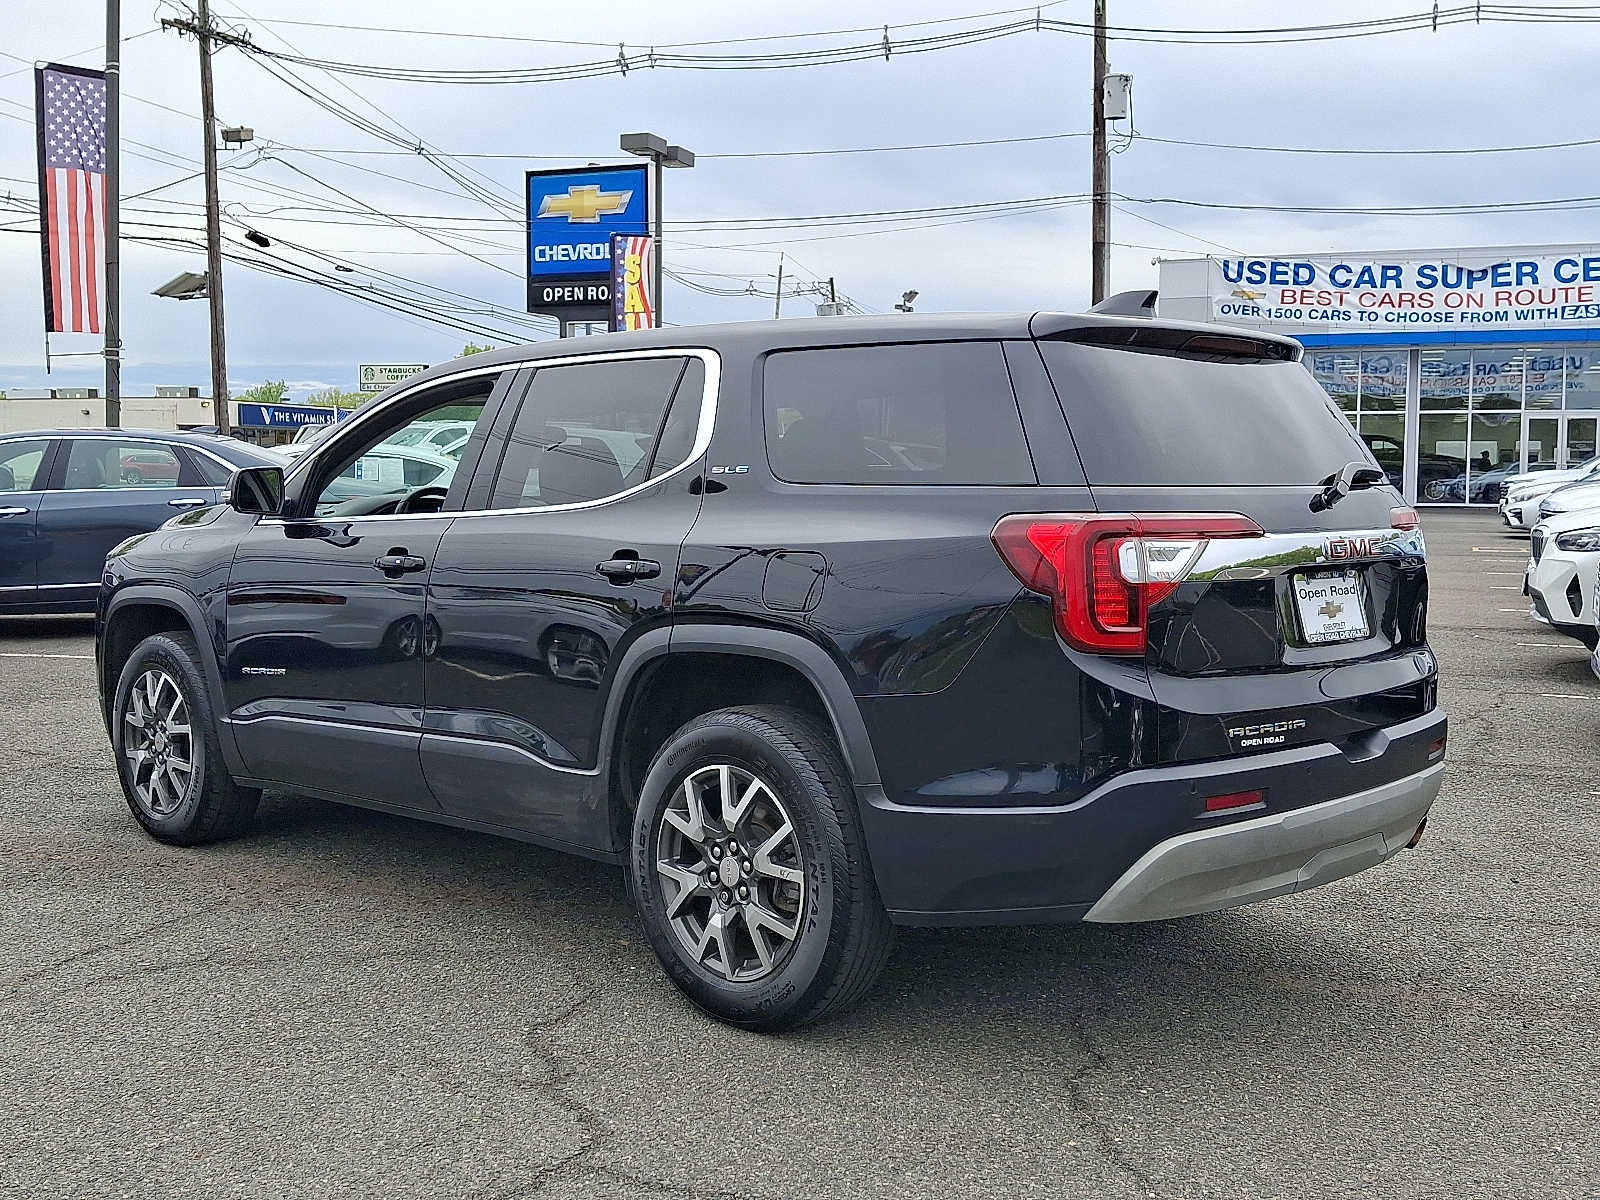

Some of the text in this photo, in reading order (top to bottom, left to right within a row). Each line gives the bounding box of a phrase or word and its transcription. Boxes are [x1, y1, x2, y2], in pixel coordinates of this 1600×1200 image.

[1222, 259, 1316, 286] USED
[1329, 263, 1403, 289] CAR
[1415, 262, 1539, 289] SUPER
[543, 286, 612, 301] OPEN RO
[1280, 286, 1594, 309] BEST CARS ON ROUTE
[1220, 304, 1260, 317] OVER
[1265, 308, 1303, 320] 1500
[1308, 309, 1352, 321] CARS
[1358, 310, 1379, 322] TO
[1384, 311, 1454, 323] CHOOSE
[1460, 310, 1508, 323] FROM
[1515, 308, 1558, 320] WITH
[274, 412, 290, 422] THE
[292, 413, 325, 425] VITAMIN
[711, 465, 749, 474] SLE
[1329, 537, 1381, 560] GMC
[1299, 583, 1356, 601] Open Road
[1228, 719, 1306, 738] ACADIA
[1241, 735, 1285, 747] OPEN ROAD
